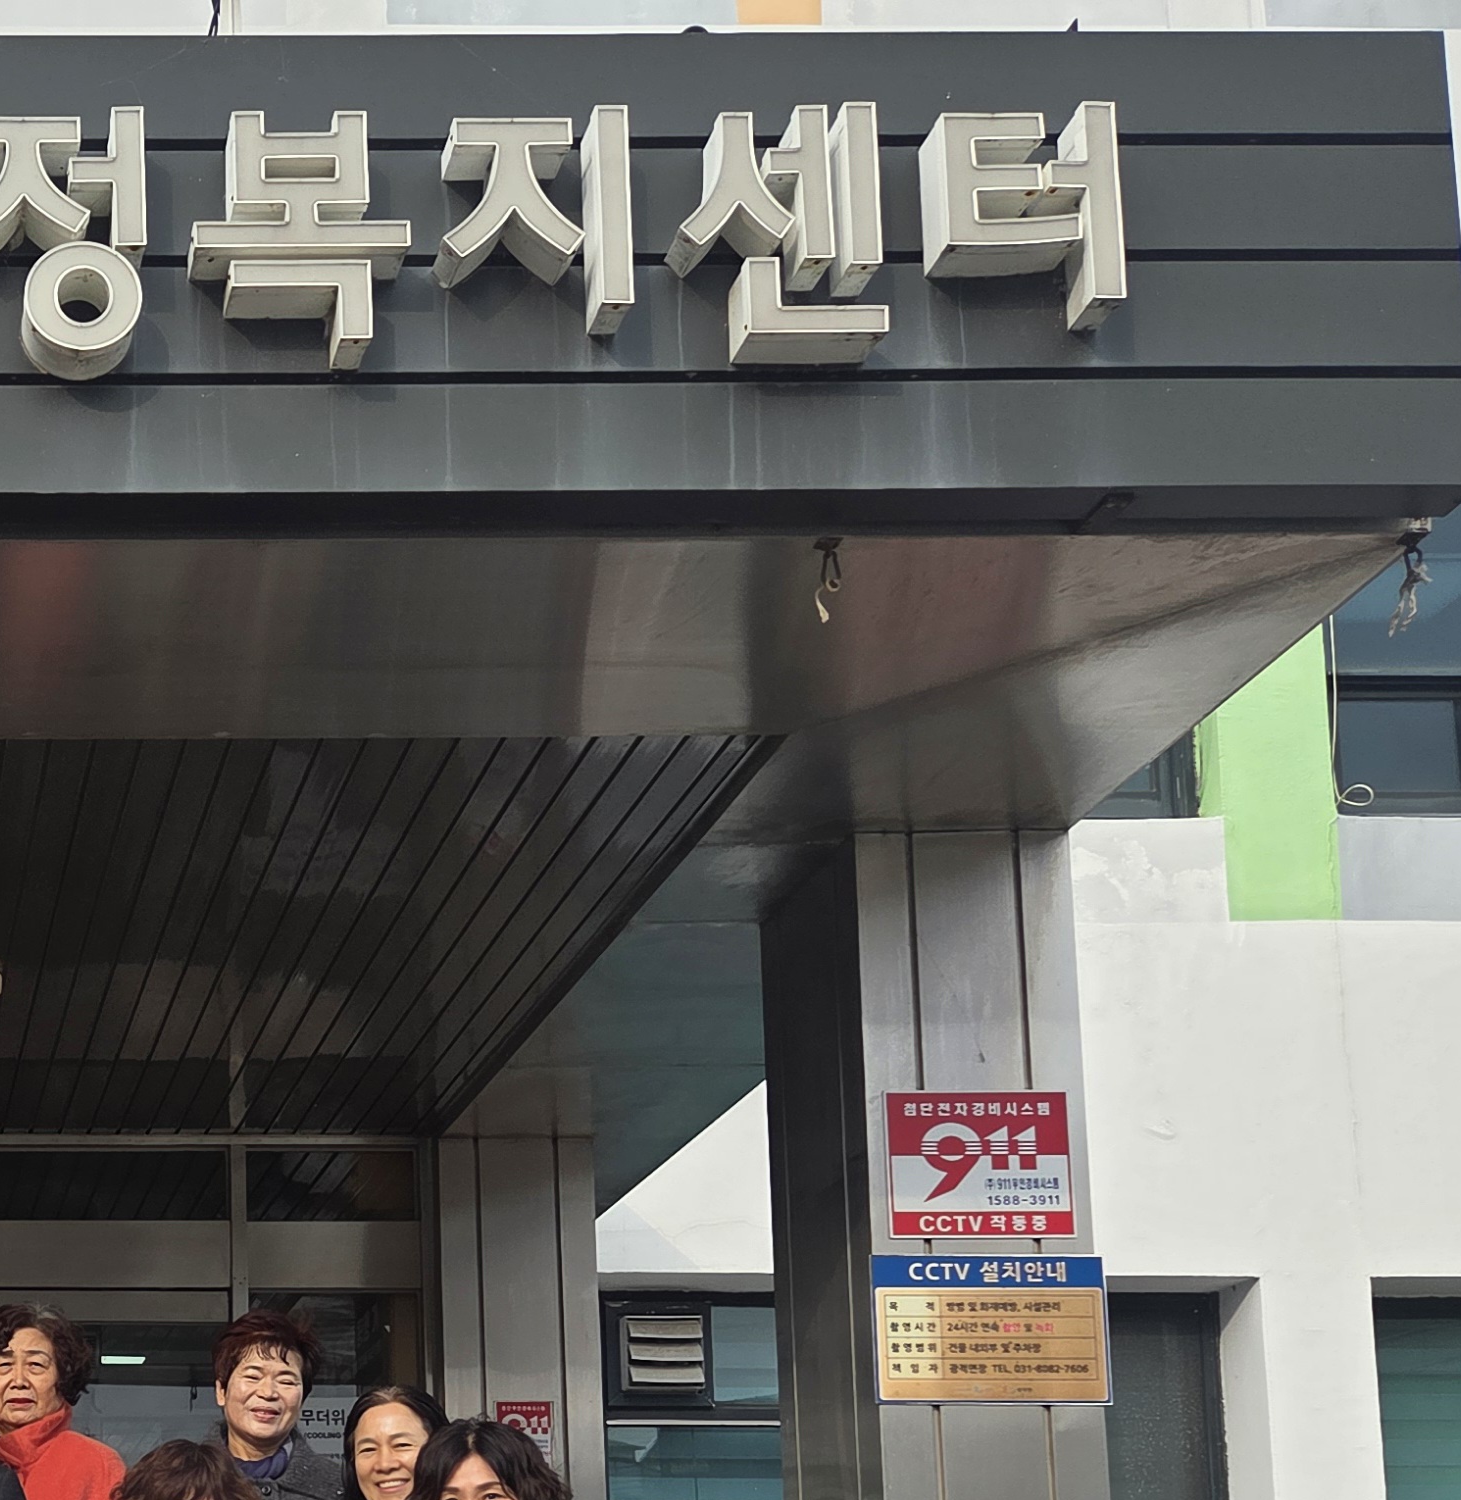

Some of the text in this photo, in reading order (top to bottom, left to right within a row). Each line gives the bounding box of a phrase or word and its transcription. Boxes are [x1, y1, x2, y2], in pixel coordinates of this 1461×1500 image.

[920, 1122, 1037, 1203] 911
[986, 1194, 1061, 1206] 1588-3911
[919, 1215, 983, 1232] CCTV
[908, 1261, 1067, 1283] CCTV 설치안내
[947, 1322, 978, 1333] 24시간
